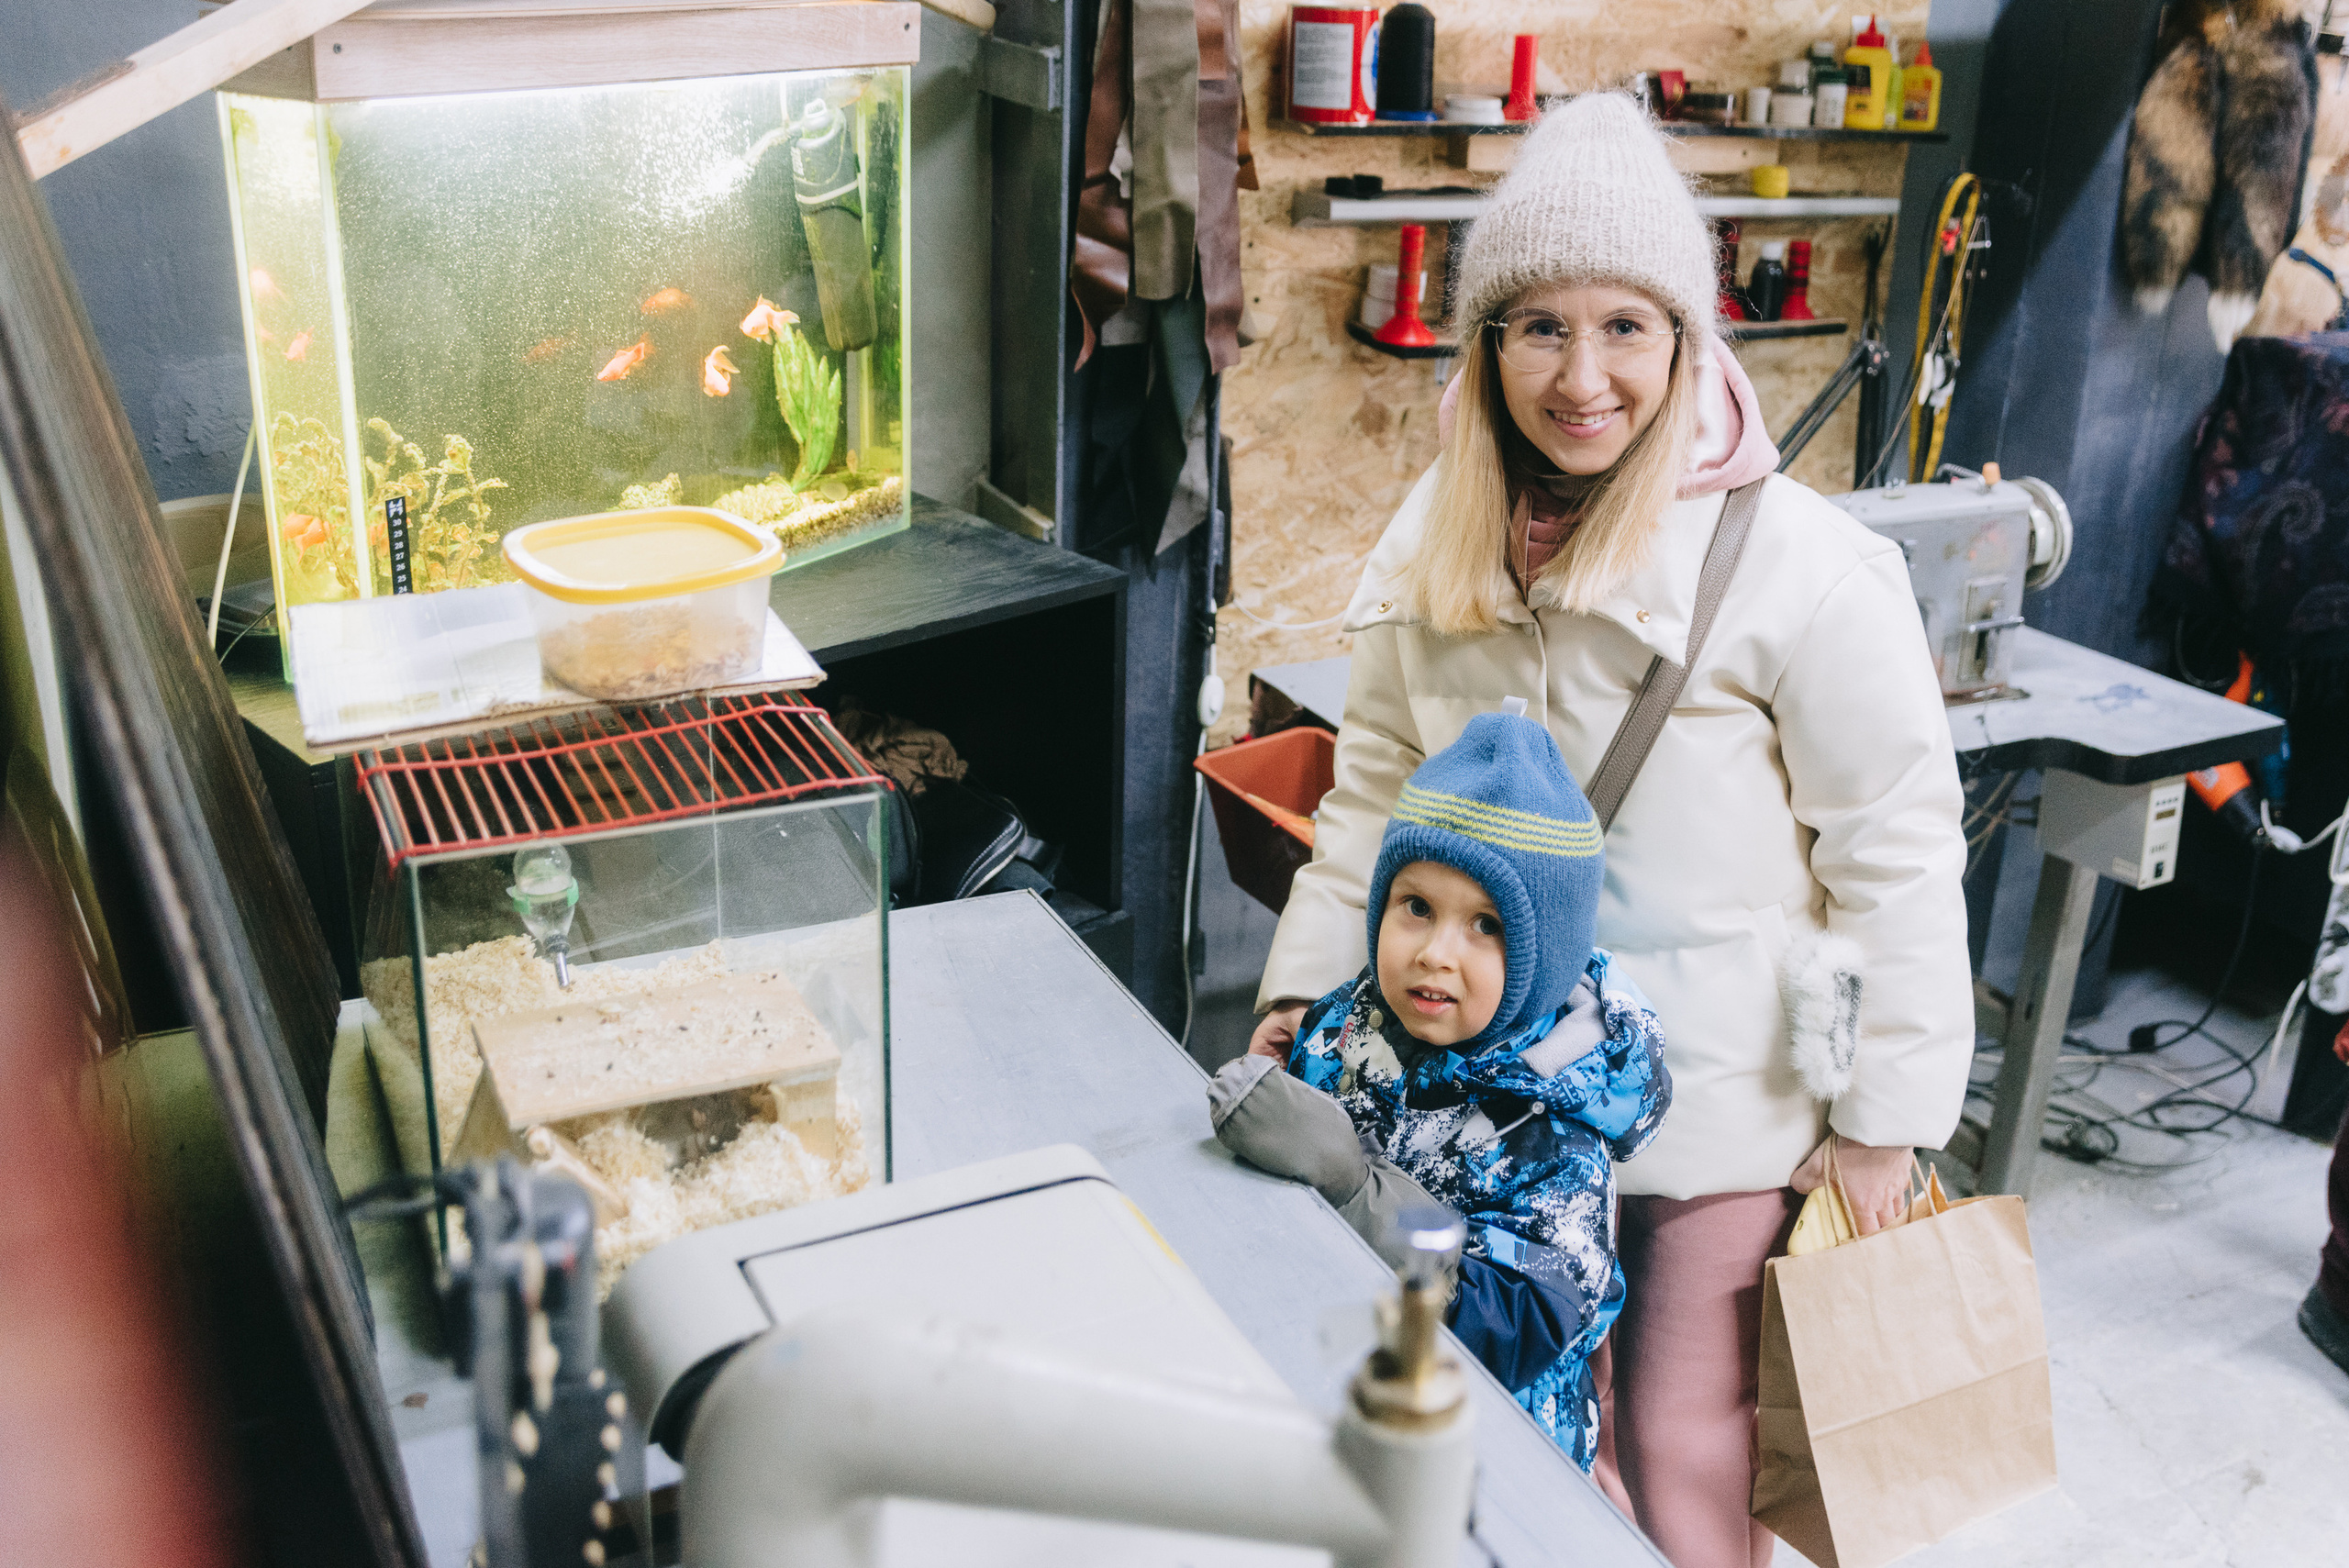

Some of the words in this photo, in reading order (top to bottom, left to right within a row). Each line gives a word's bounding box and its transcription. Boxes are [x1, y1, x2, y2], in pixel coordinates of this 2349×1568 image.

[393, 518, 402, 527] 30
[394, 529, 403, 539] 29
[395, 541, 404, 550] 28
[395, 552, 405, 561] 27
[396, 563, 406, 572] 26
[397, 574, 406, 584] 25
[398, 585, 407, 594] 24
